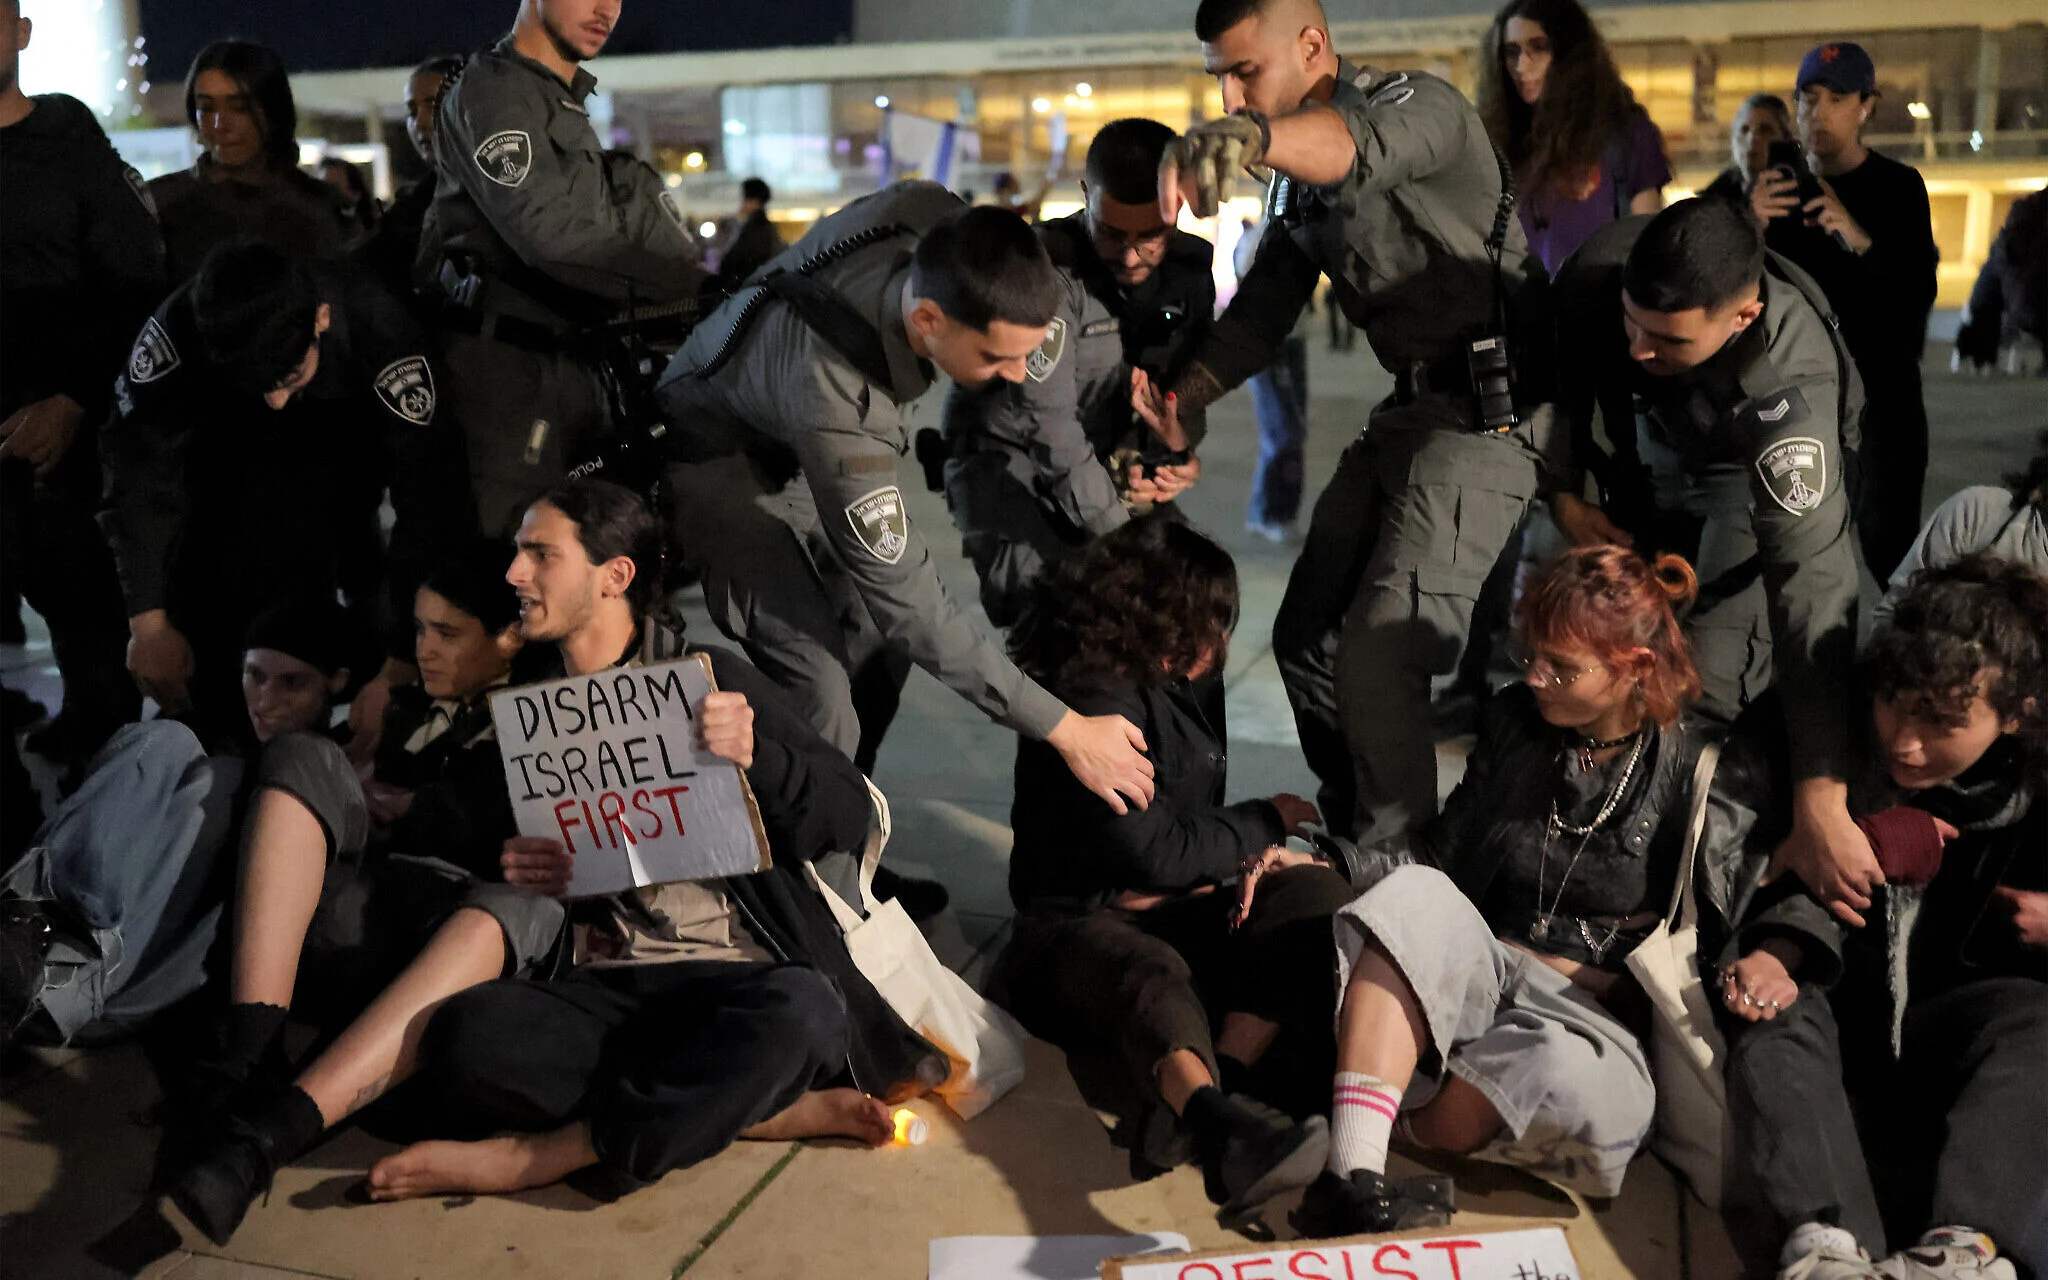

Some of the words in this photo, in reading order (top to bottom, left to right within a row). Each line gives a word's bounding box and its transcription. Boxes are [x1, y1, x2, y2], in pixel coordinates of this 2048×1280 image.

[567, 455, 605, 480] POLIC
[514, 669, 693, 742] DISARM
[511, 734, 698, 801] ISRAEL
[554, 786, 689, 854] FIRST
